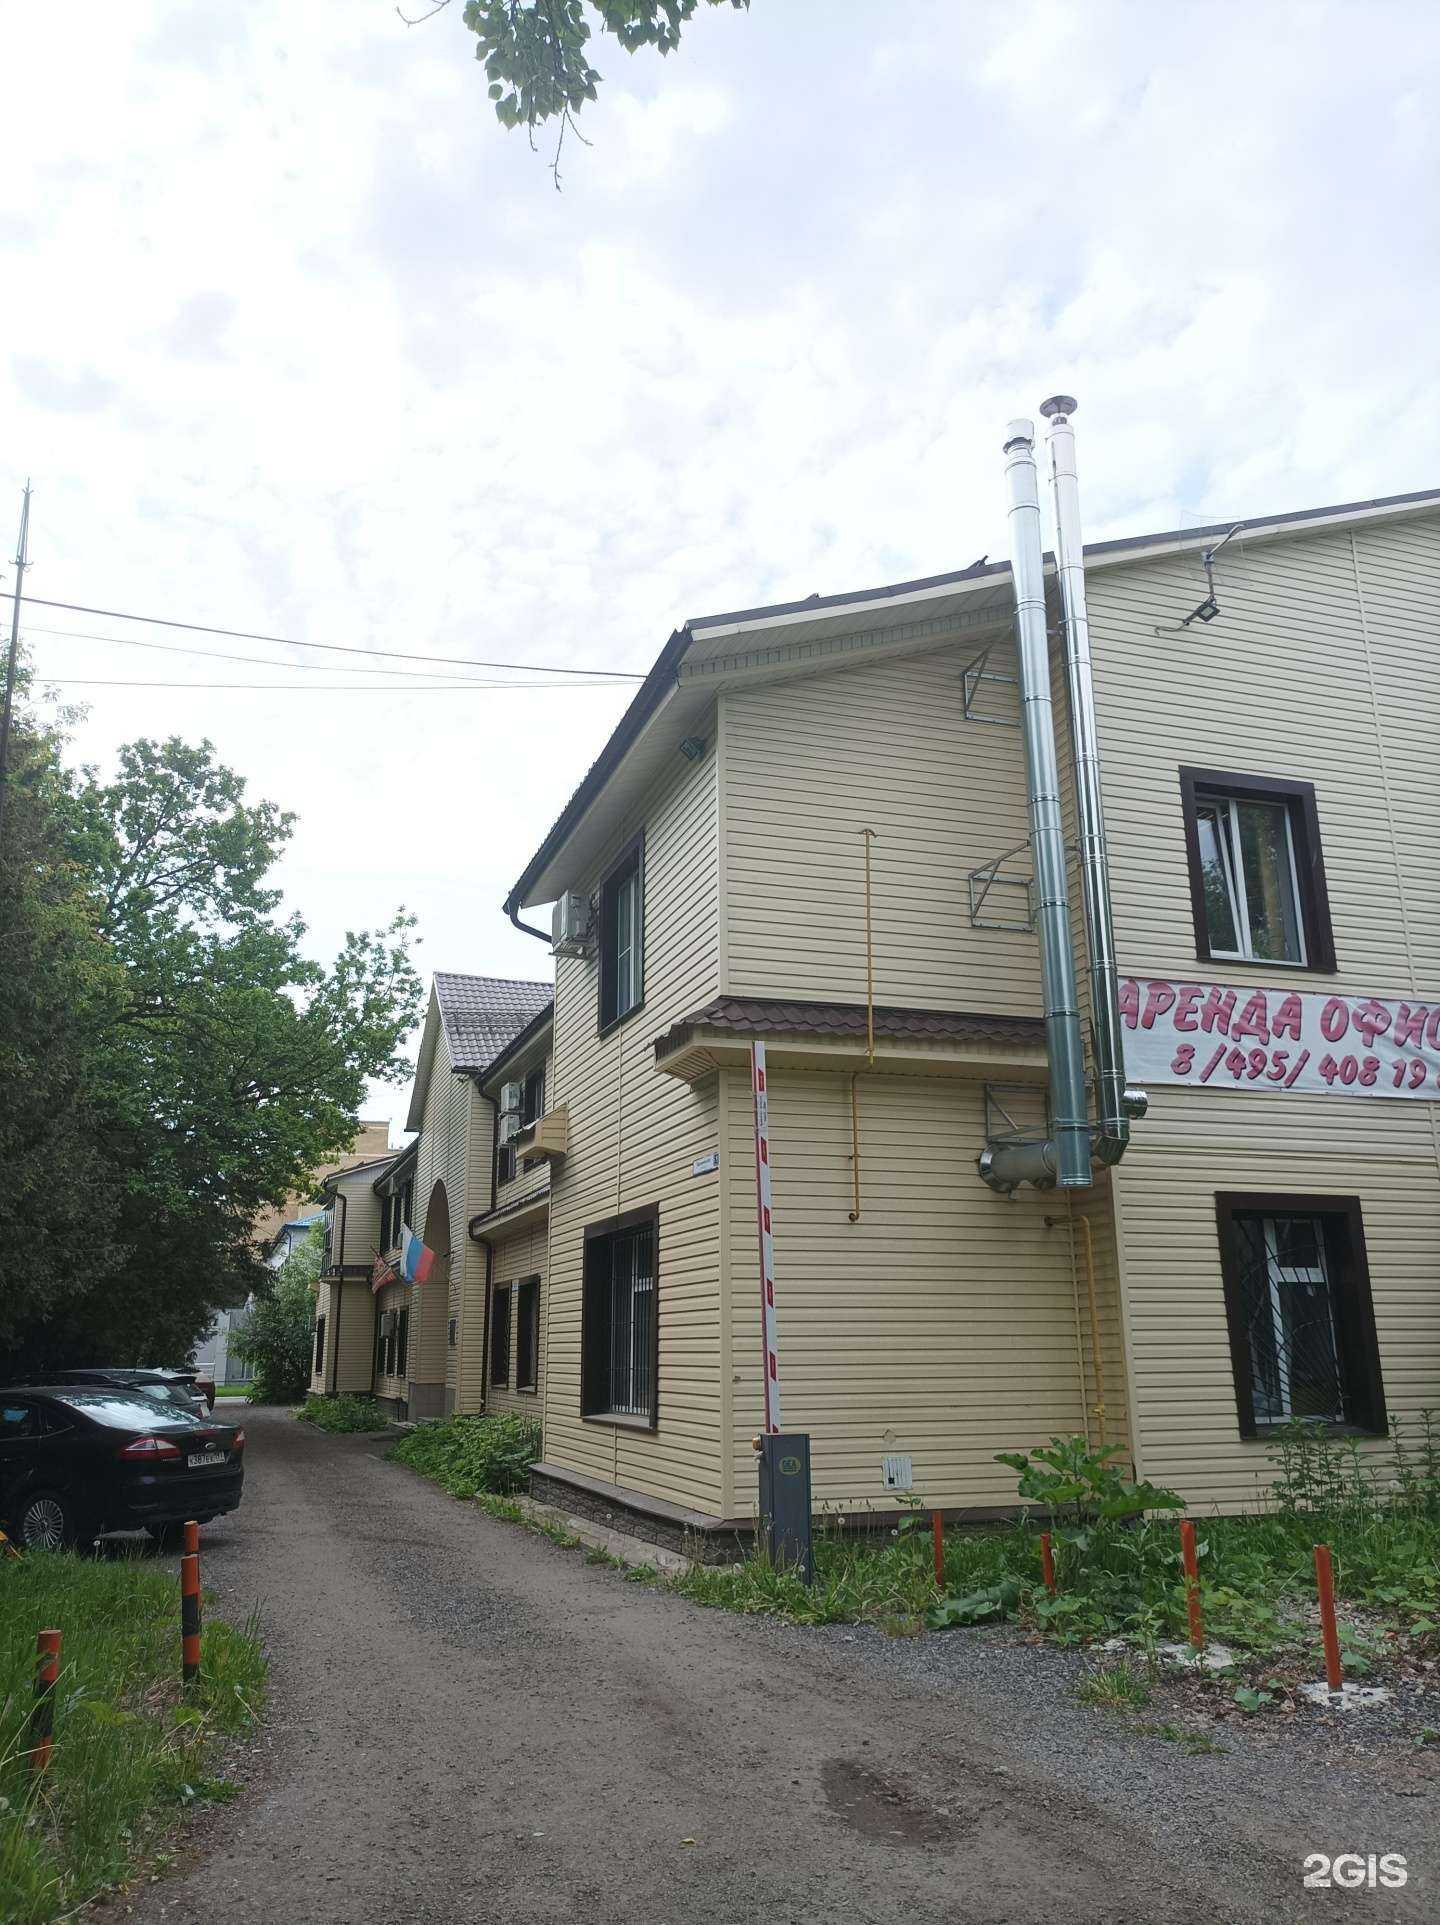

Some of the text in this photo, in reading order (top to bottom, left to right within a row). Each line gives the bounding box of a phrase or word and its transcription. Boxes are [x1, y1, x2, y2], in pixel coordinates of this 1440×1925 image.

[1118, 978, 1303, 1046] АРЕНДА
[1318, 1053, 1381, 1087] 408
[1391, 1058, 1427, 1090] 19
